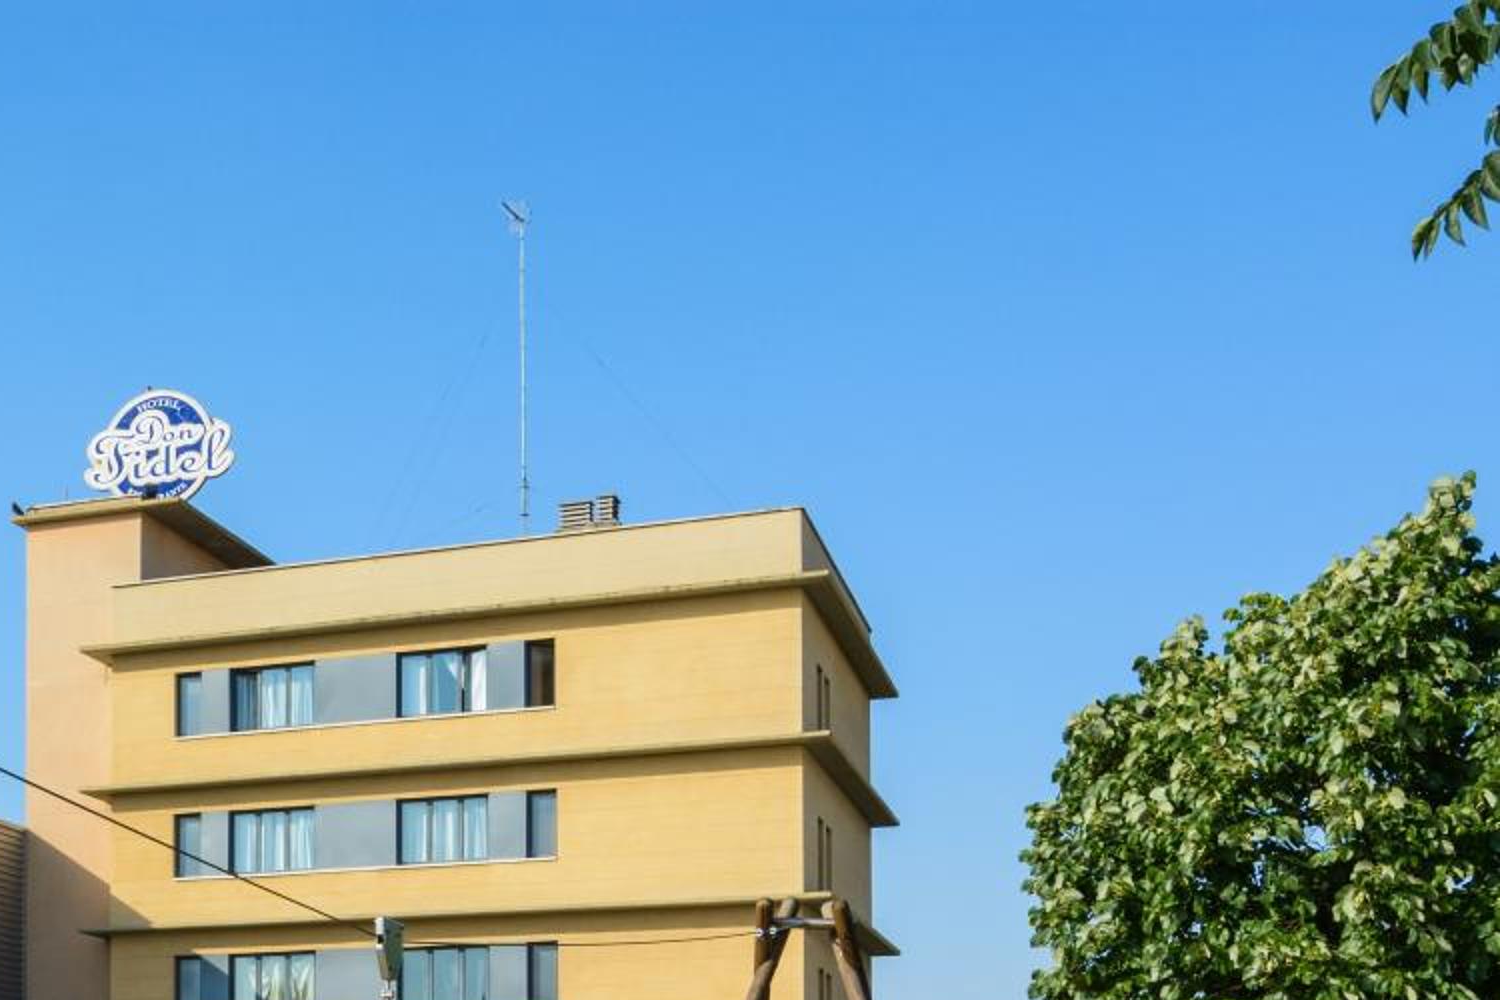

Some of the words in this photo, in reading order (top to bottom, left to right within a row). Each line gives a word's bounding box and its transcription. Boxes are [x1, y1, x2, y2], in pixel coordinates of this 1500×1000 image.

[137, 398, 181, 413] HOTEL
[132, 412, 202, 446] Don
[88, 423, 231, 486] Fidel
